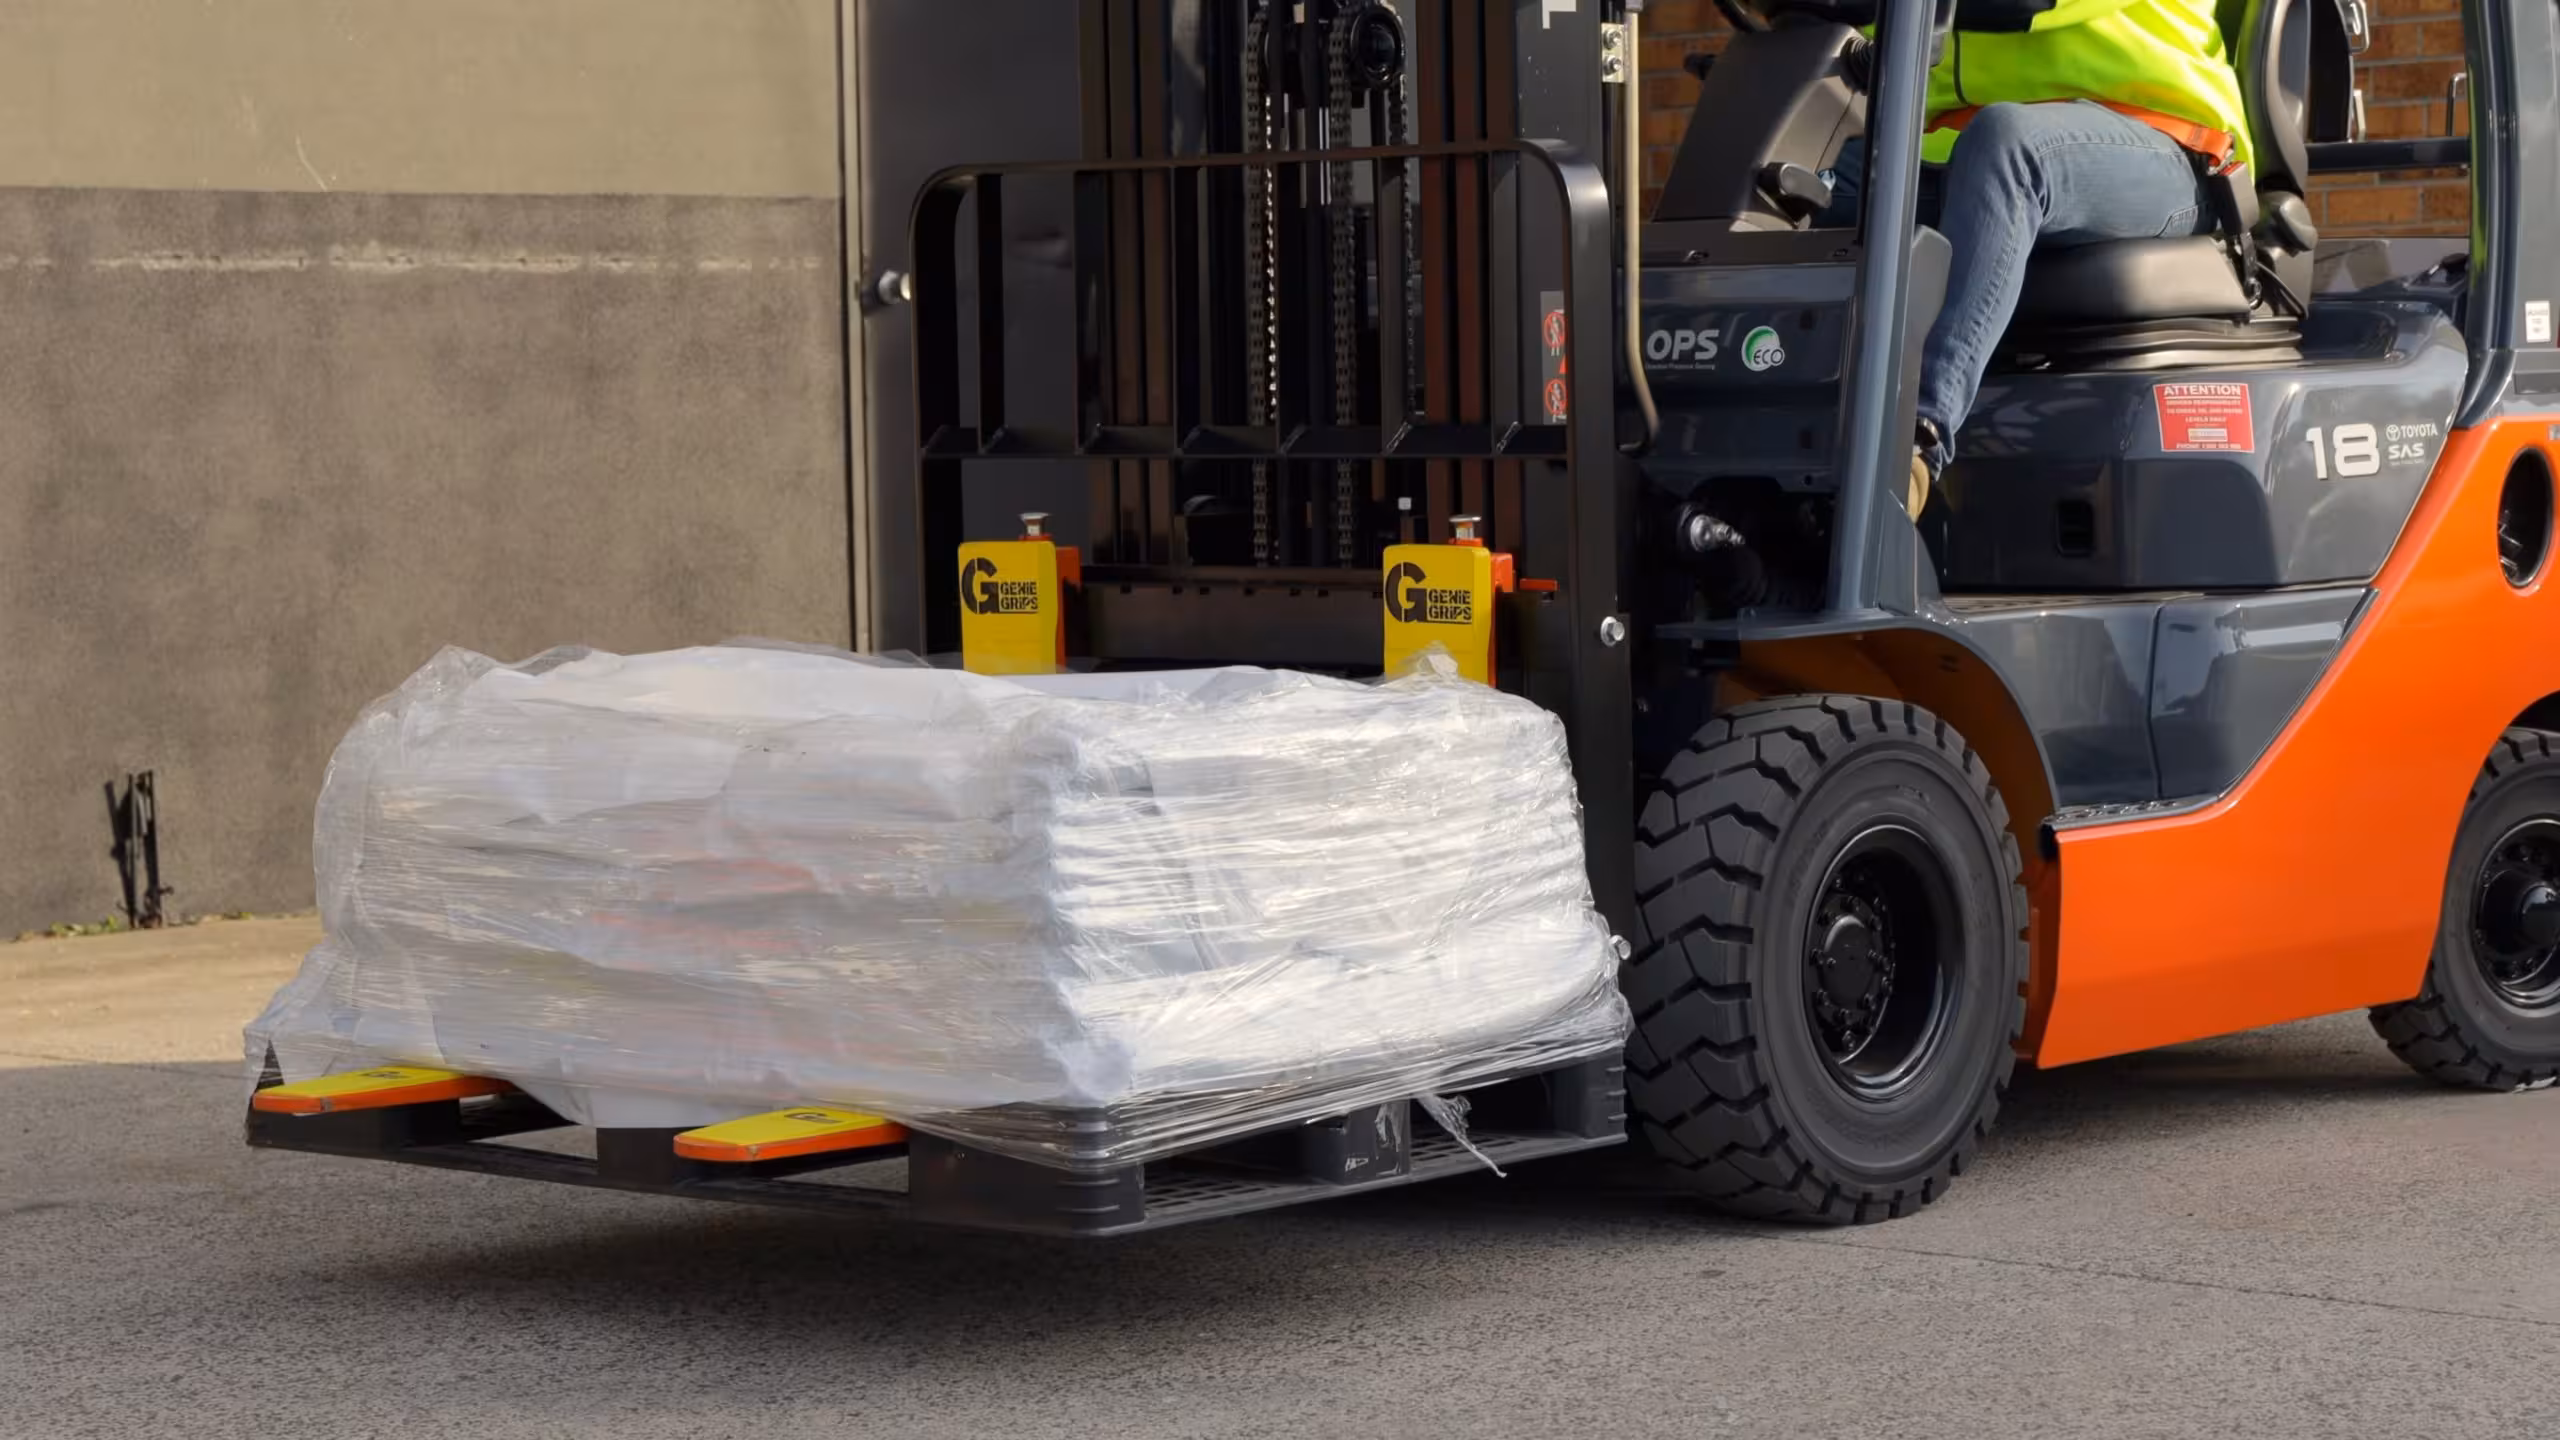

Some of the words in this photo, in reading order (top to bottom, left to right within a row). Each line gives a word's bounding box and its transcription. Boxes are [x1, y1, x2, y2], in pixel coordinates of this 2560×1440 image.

[1647, 329, 1720, 360] OPS
[1753, 349, 1784, 365] ECO
[2164, 385, 2241, 396] ATTENTION
[2401, 423, 2438, 438] TOYOTA
[2306, 423, 2380, 479] 18
[2388, 443, 2424, 459] SAS
